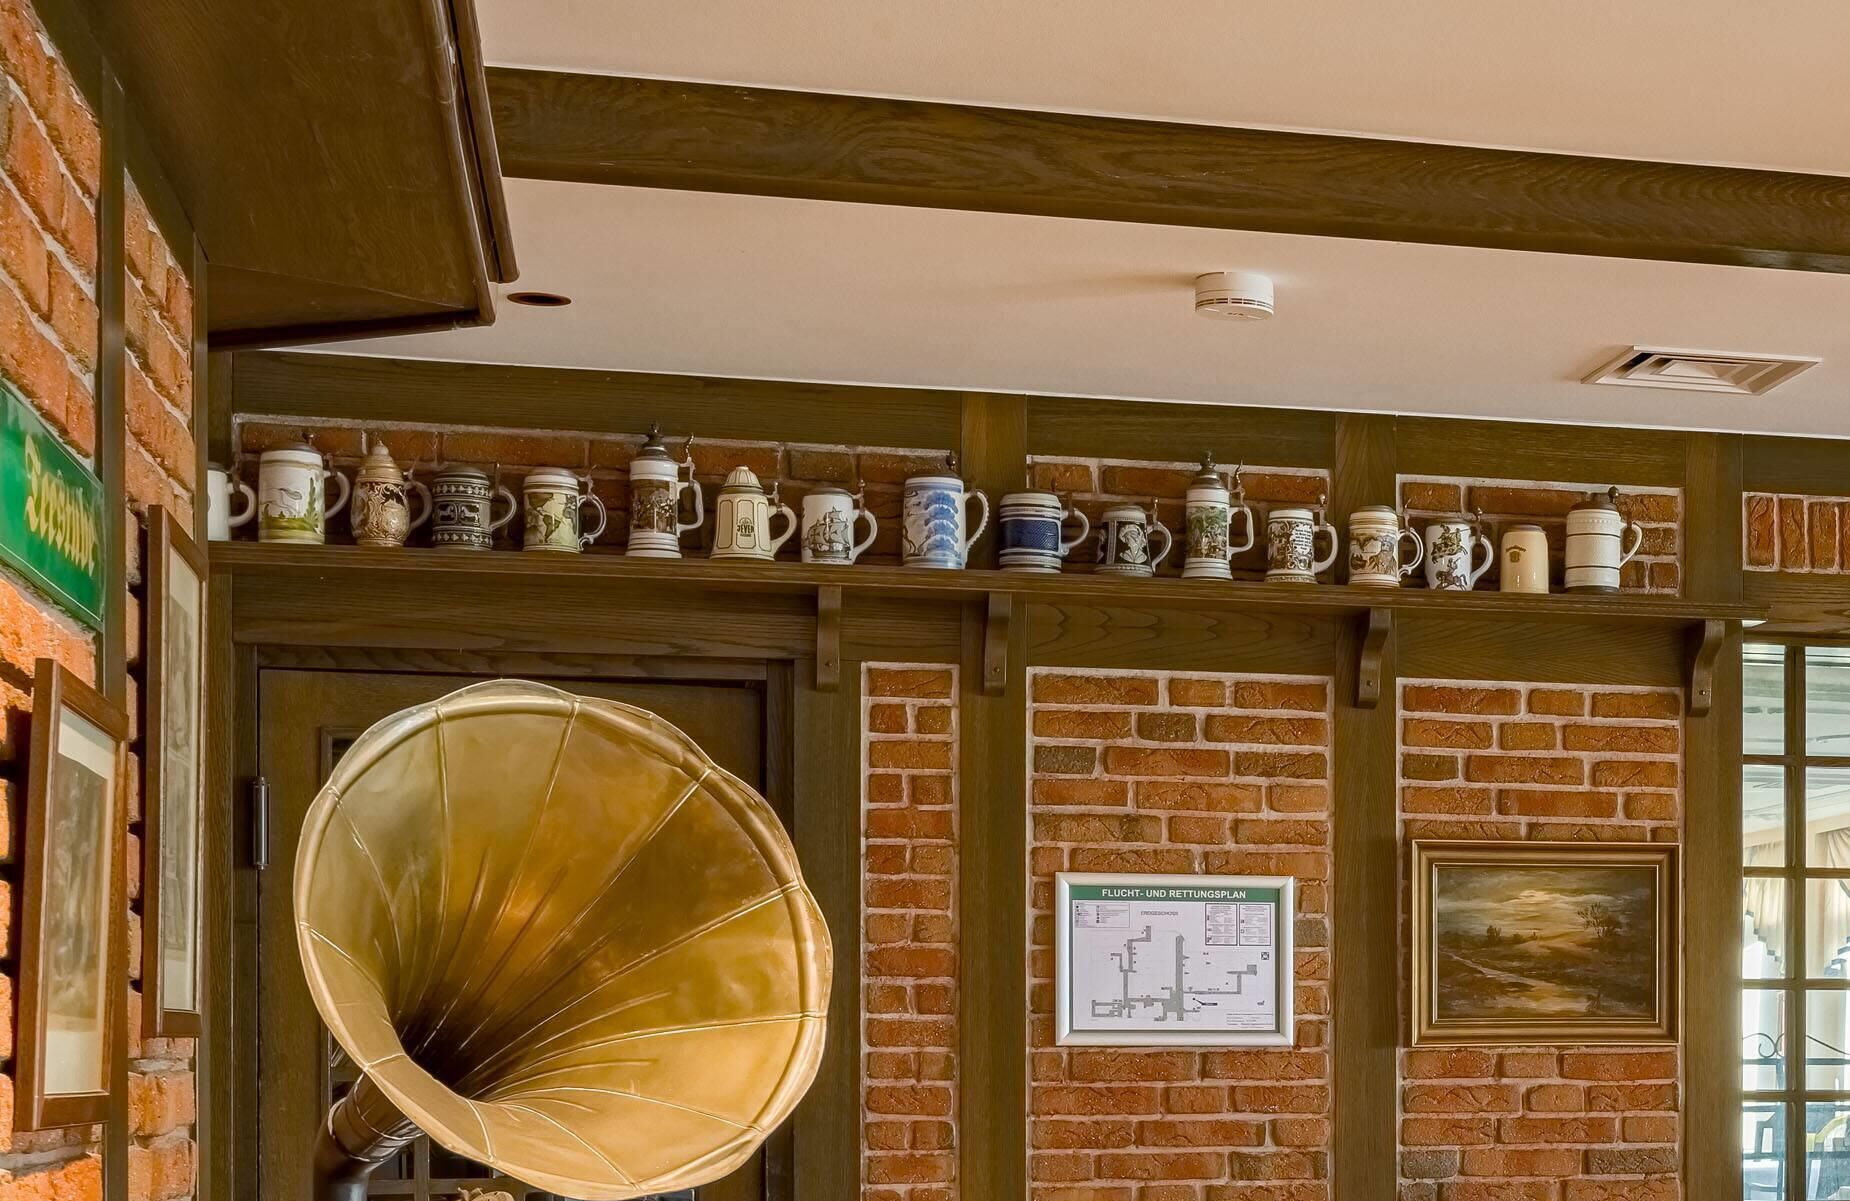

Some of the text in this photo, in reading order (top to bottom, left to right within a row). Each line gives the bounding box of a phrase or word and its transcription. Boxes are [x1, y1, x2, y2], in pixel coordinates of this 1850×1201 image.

[1101, 888, 1246, 899] FLUCHT- UND RETTUNGSPLAN
